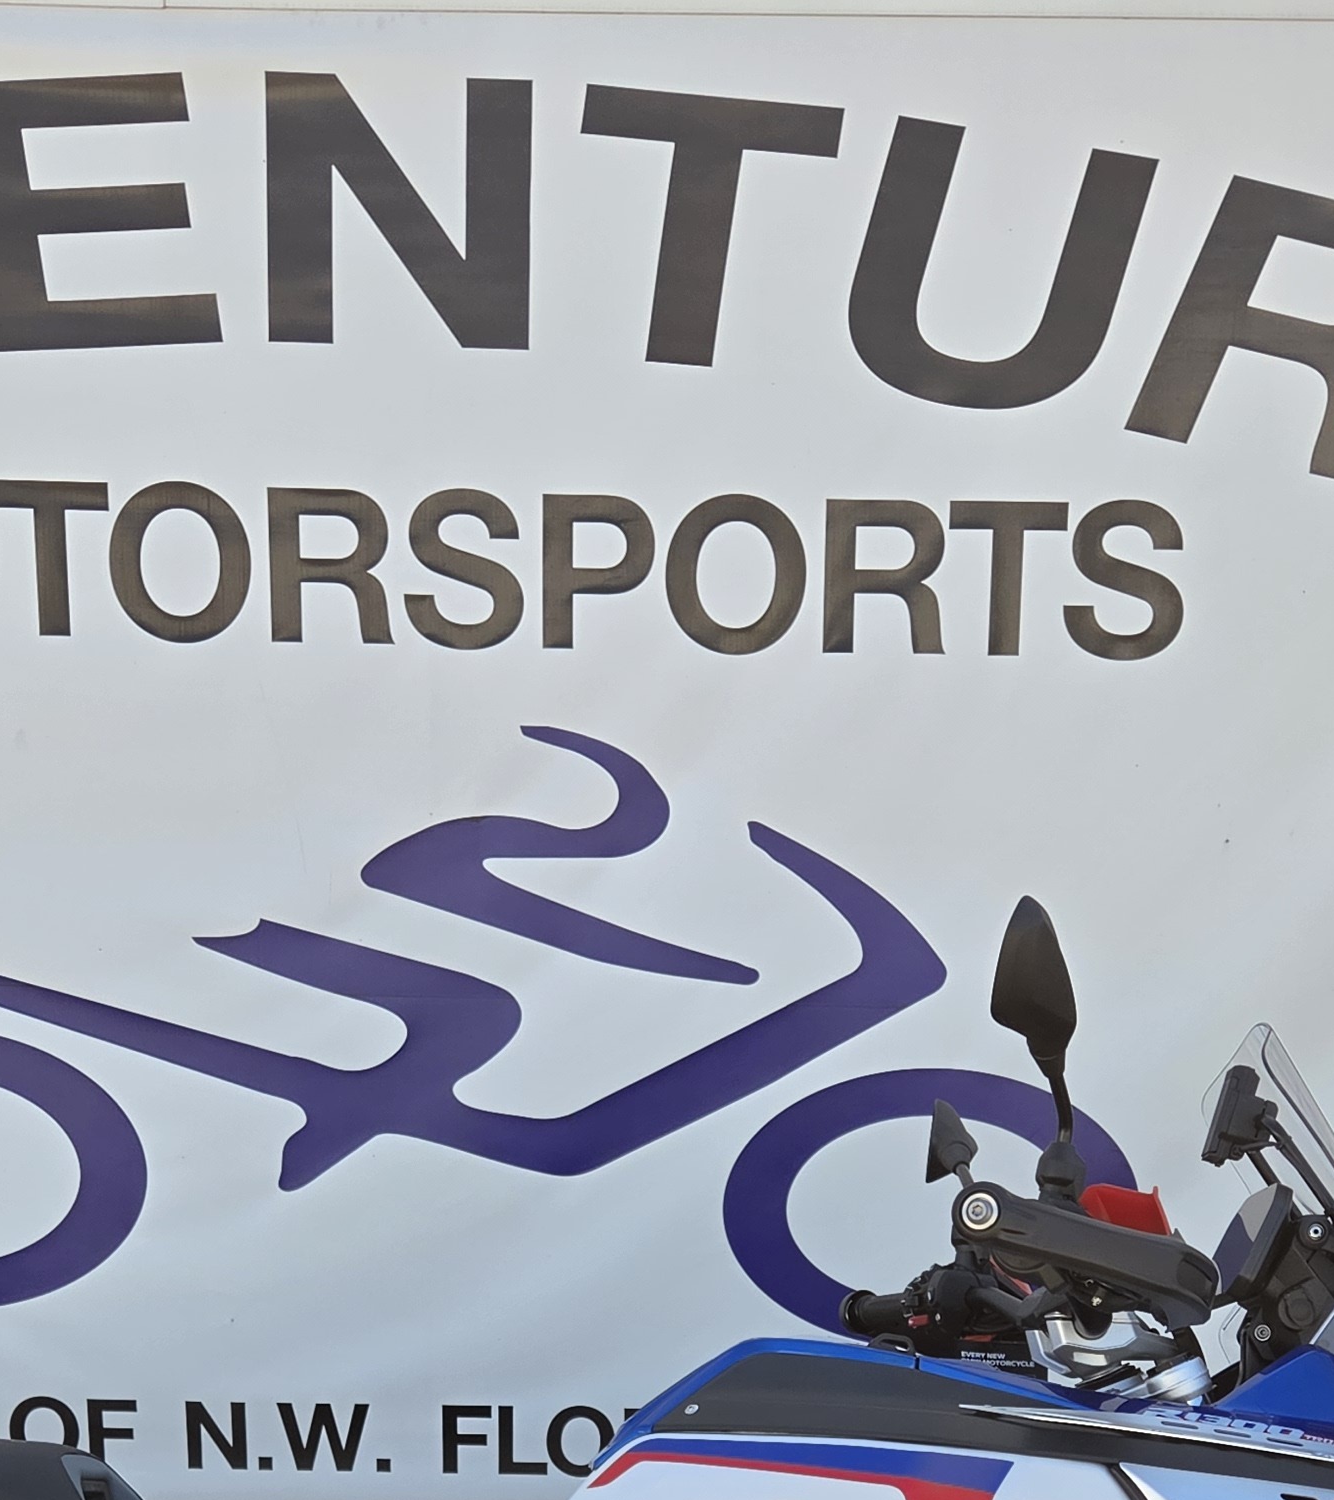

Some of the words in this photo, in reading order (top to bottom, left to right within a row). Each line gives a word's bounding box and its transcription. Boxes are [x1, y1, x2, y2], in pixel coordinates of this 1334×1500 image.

[961, 1351, 985, 1359] EVERY
[9, 1396, 137, 1463] OF
[185, 1401, 391, 1473] N.W.
[442, 1405, 637, 1478] FLO
